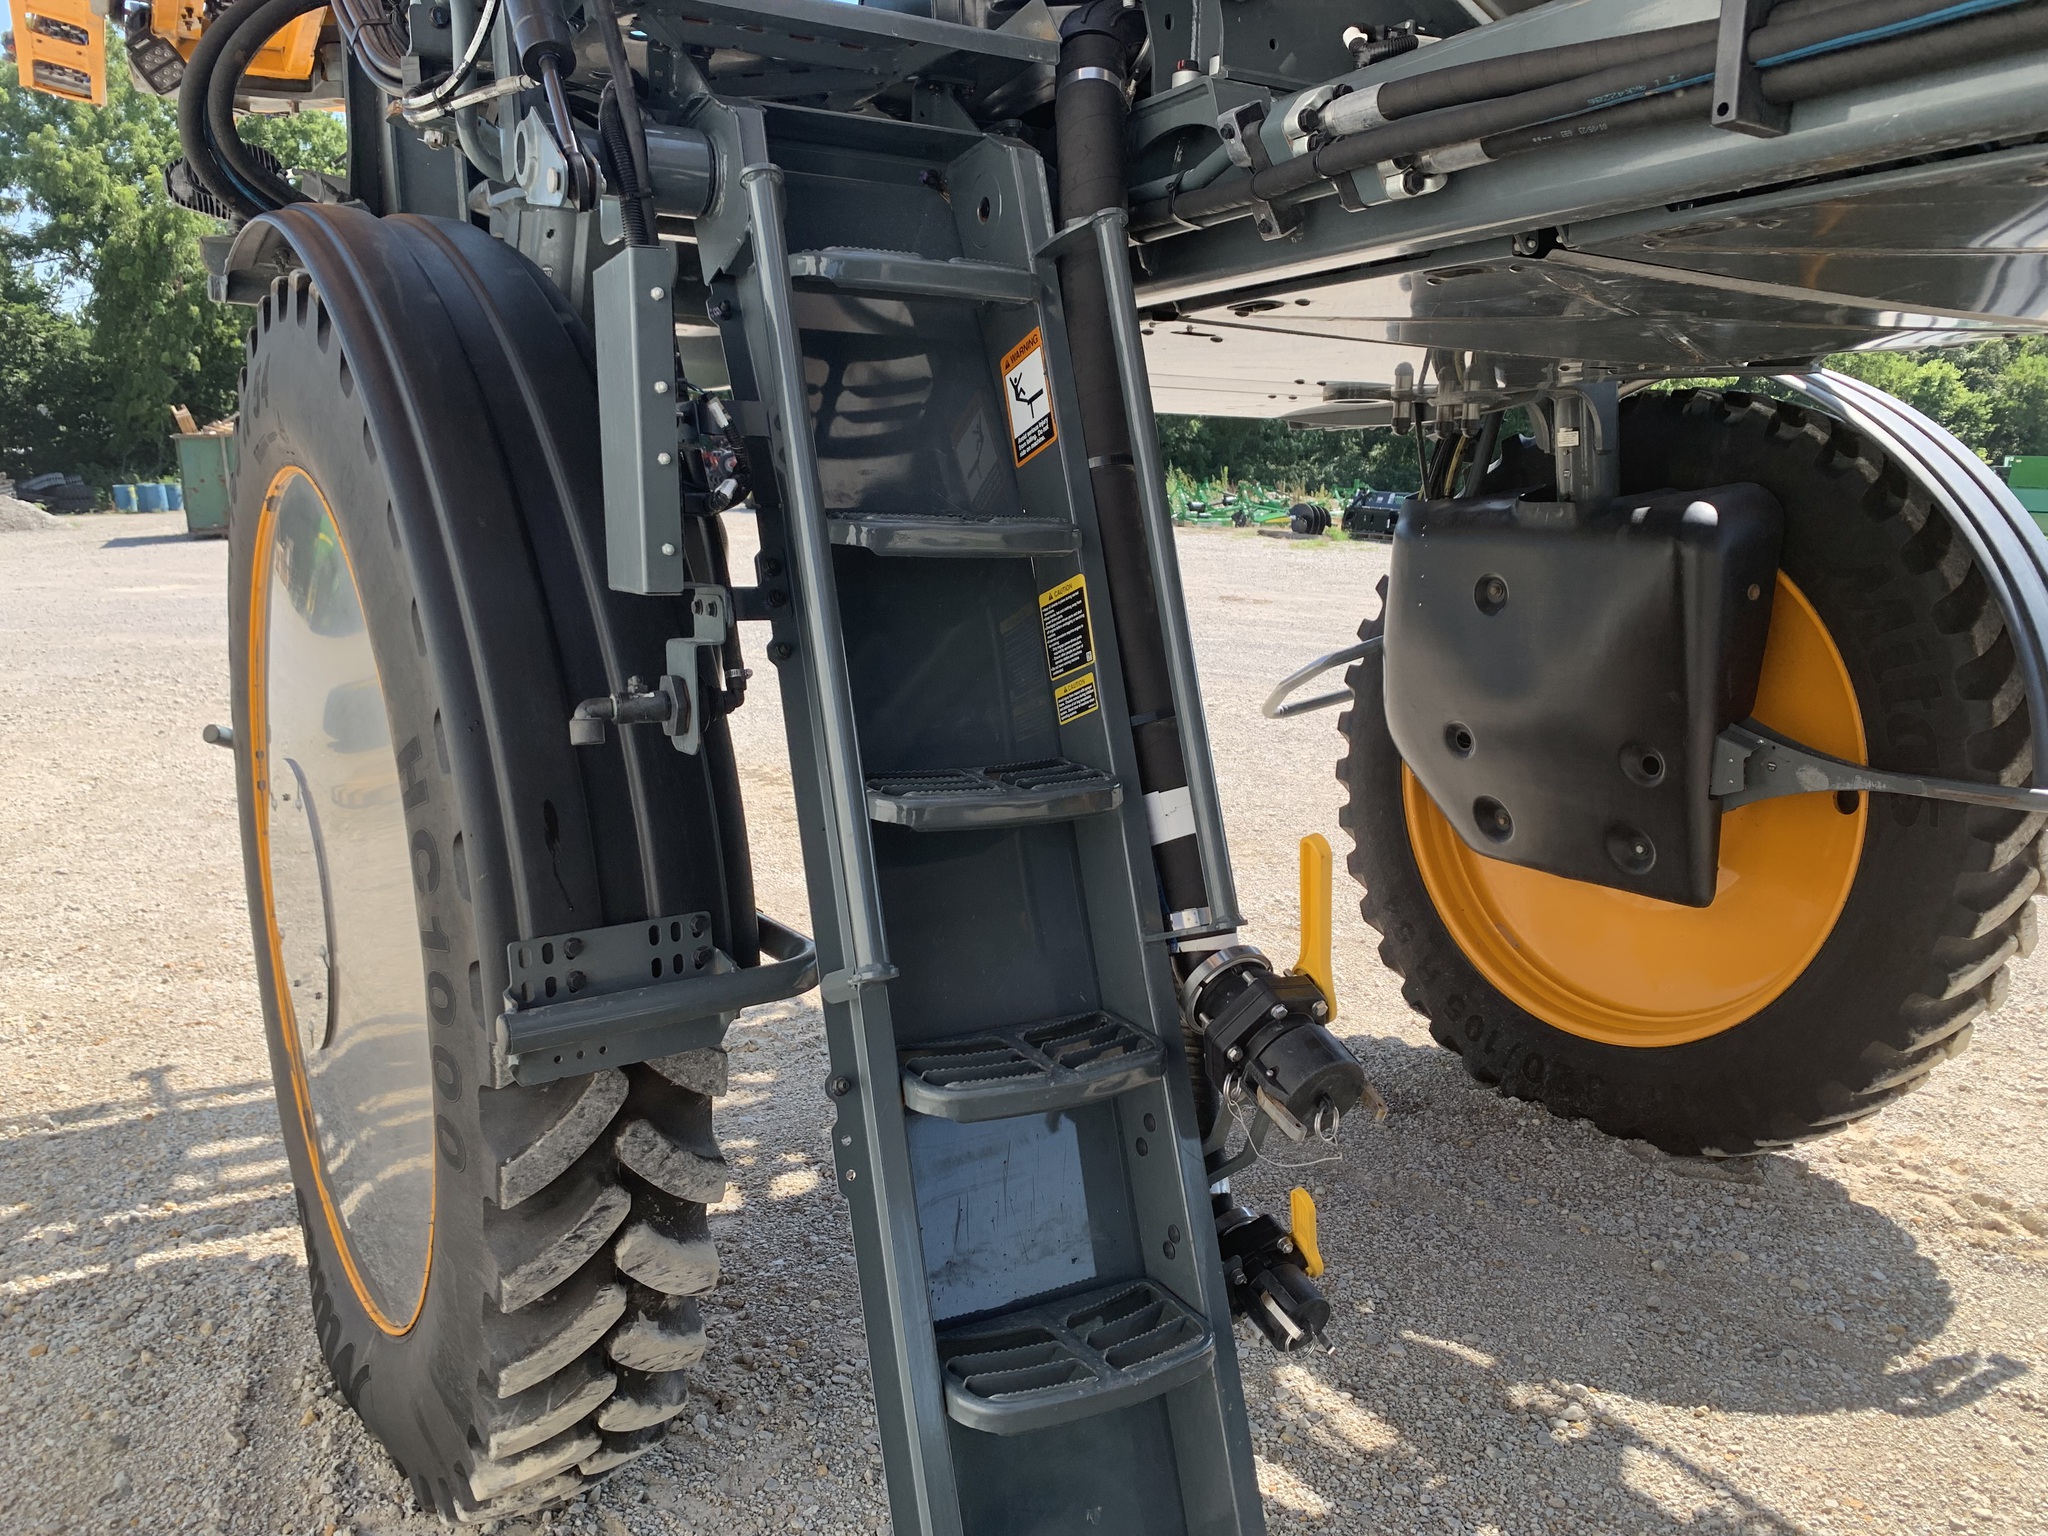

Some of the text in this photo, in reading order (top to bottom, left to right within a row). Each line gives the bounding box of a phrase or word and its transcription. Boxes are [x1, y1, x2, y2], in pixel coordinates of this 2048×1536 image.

[1010, 333, 1039, 364] WARNING
[1053, 582, 1074, 598] CAUTION
[1067, 678, 1086, 692] CAUTION
[397, 735, 467, 1175] HC1000
